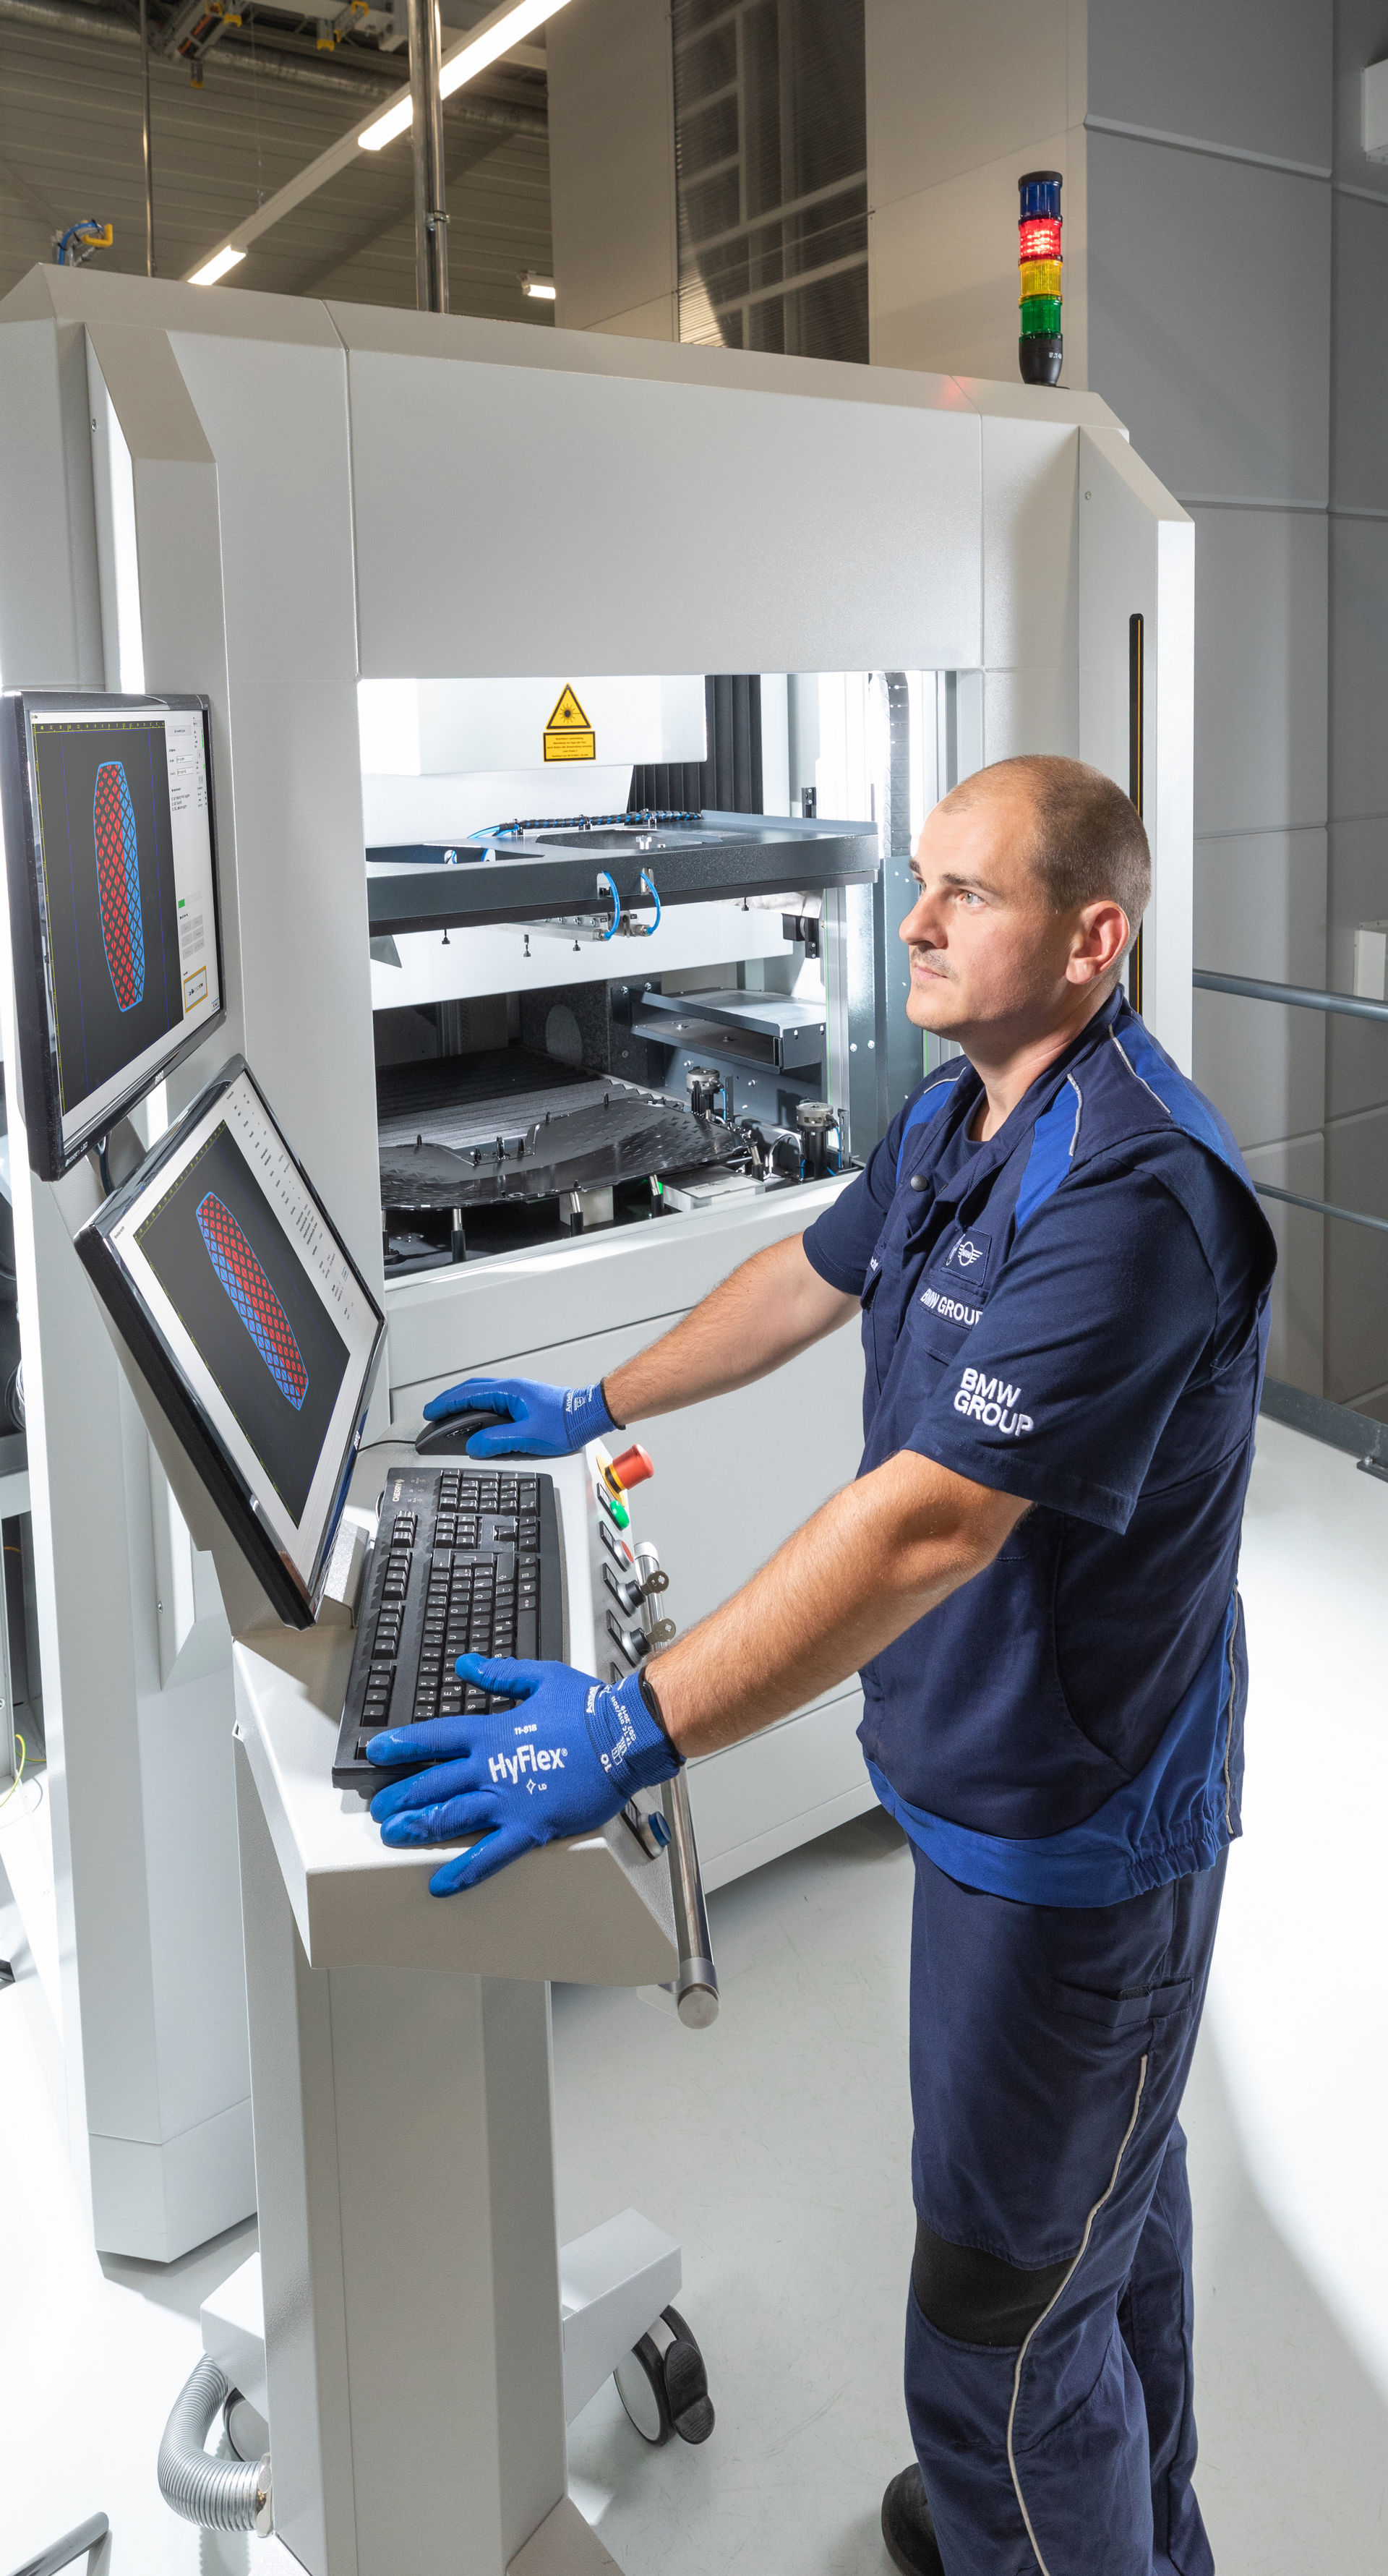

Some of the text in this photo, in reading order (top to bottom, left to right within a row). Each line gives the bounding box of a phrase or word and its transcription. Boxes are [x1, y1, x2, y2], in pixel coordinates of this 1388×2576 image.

[920, 1288, 940, 1309] BMW
[960, 1368, 1021, 1408] BMW
[954, 1390, 1034, 1437] GROUP
[393, 1482, 403, 1502] CHERRY
[514, 1724, 537, 1735] 11-818
[601, 1753, 612, 1773] 10
